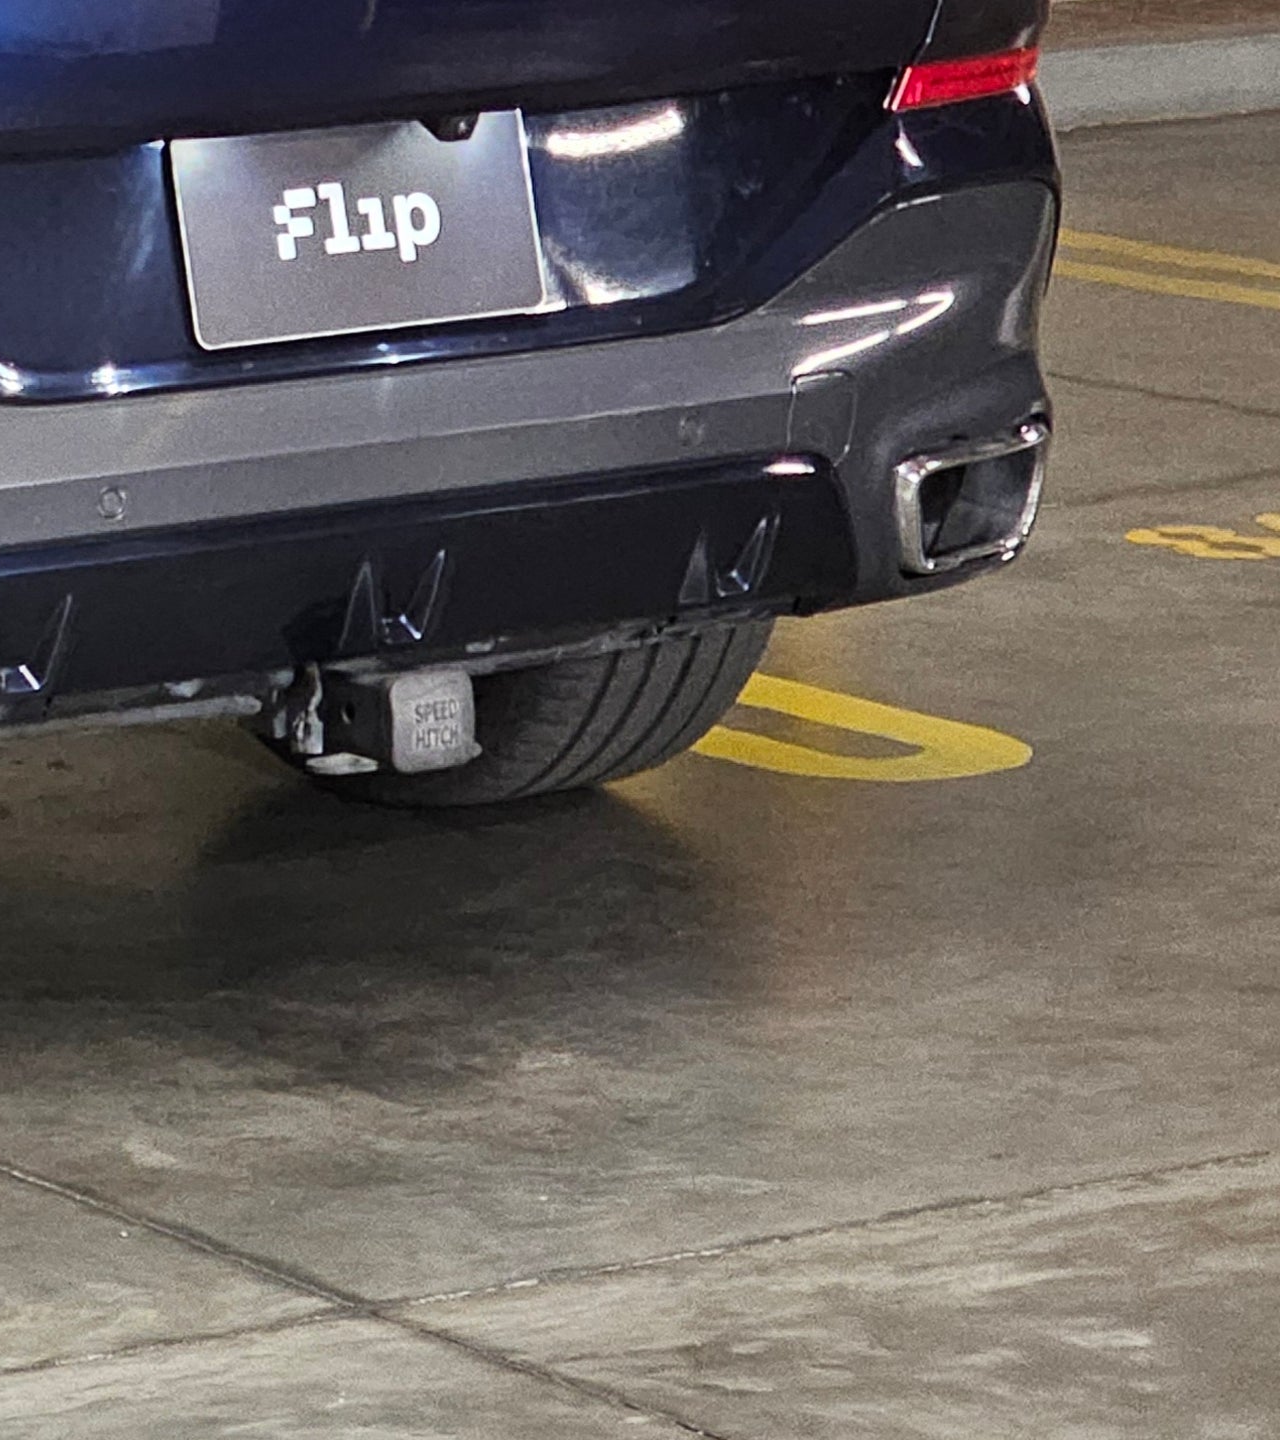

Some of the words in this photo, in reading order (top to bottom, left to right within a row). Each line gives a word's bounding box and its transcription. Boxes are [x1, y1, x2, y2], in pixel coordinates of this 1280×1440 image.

[272, 181, 442, 263] Flip
[414, 698, 458, 724] SPEED
[415, 725, 459, 750] HITCH
